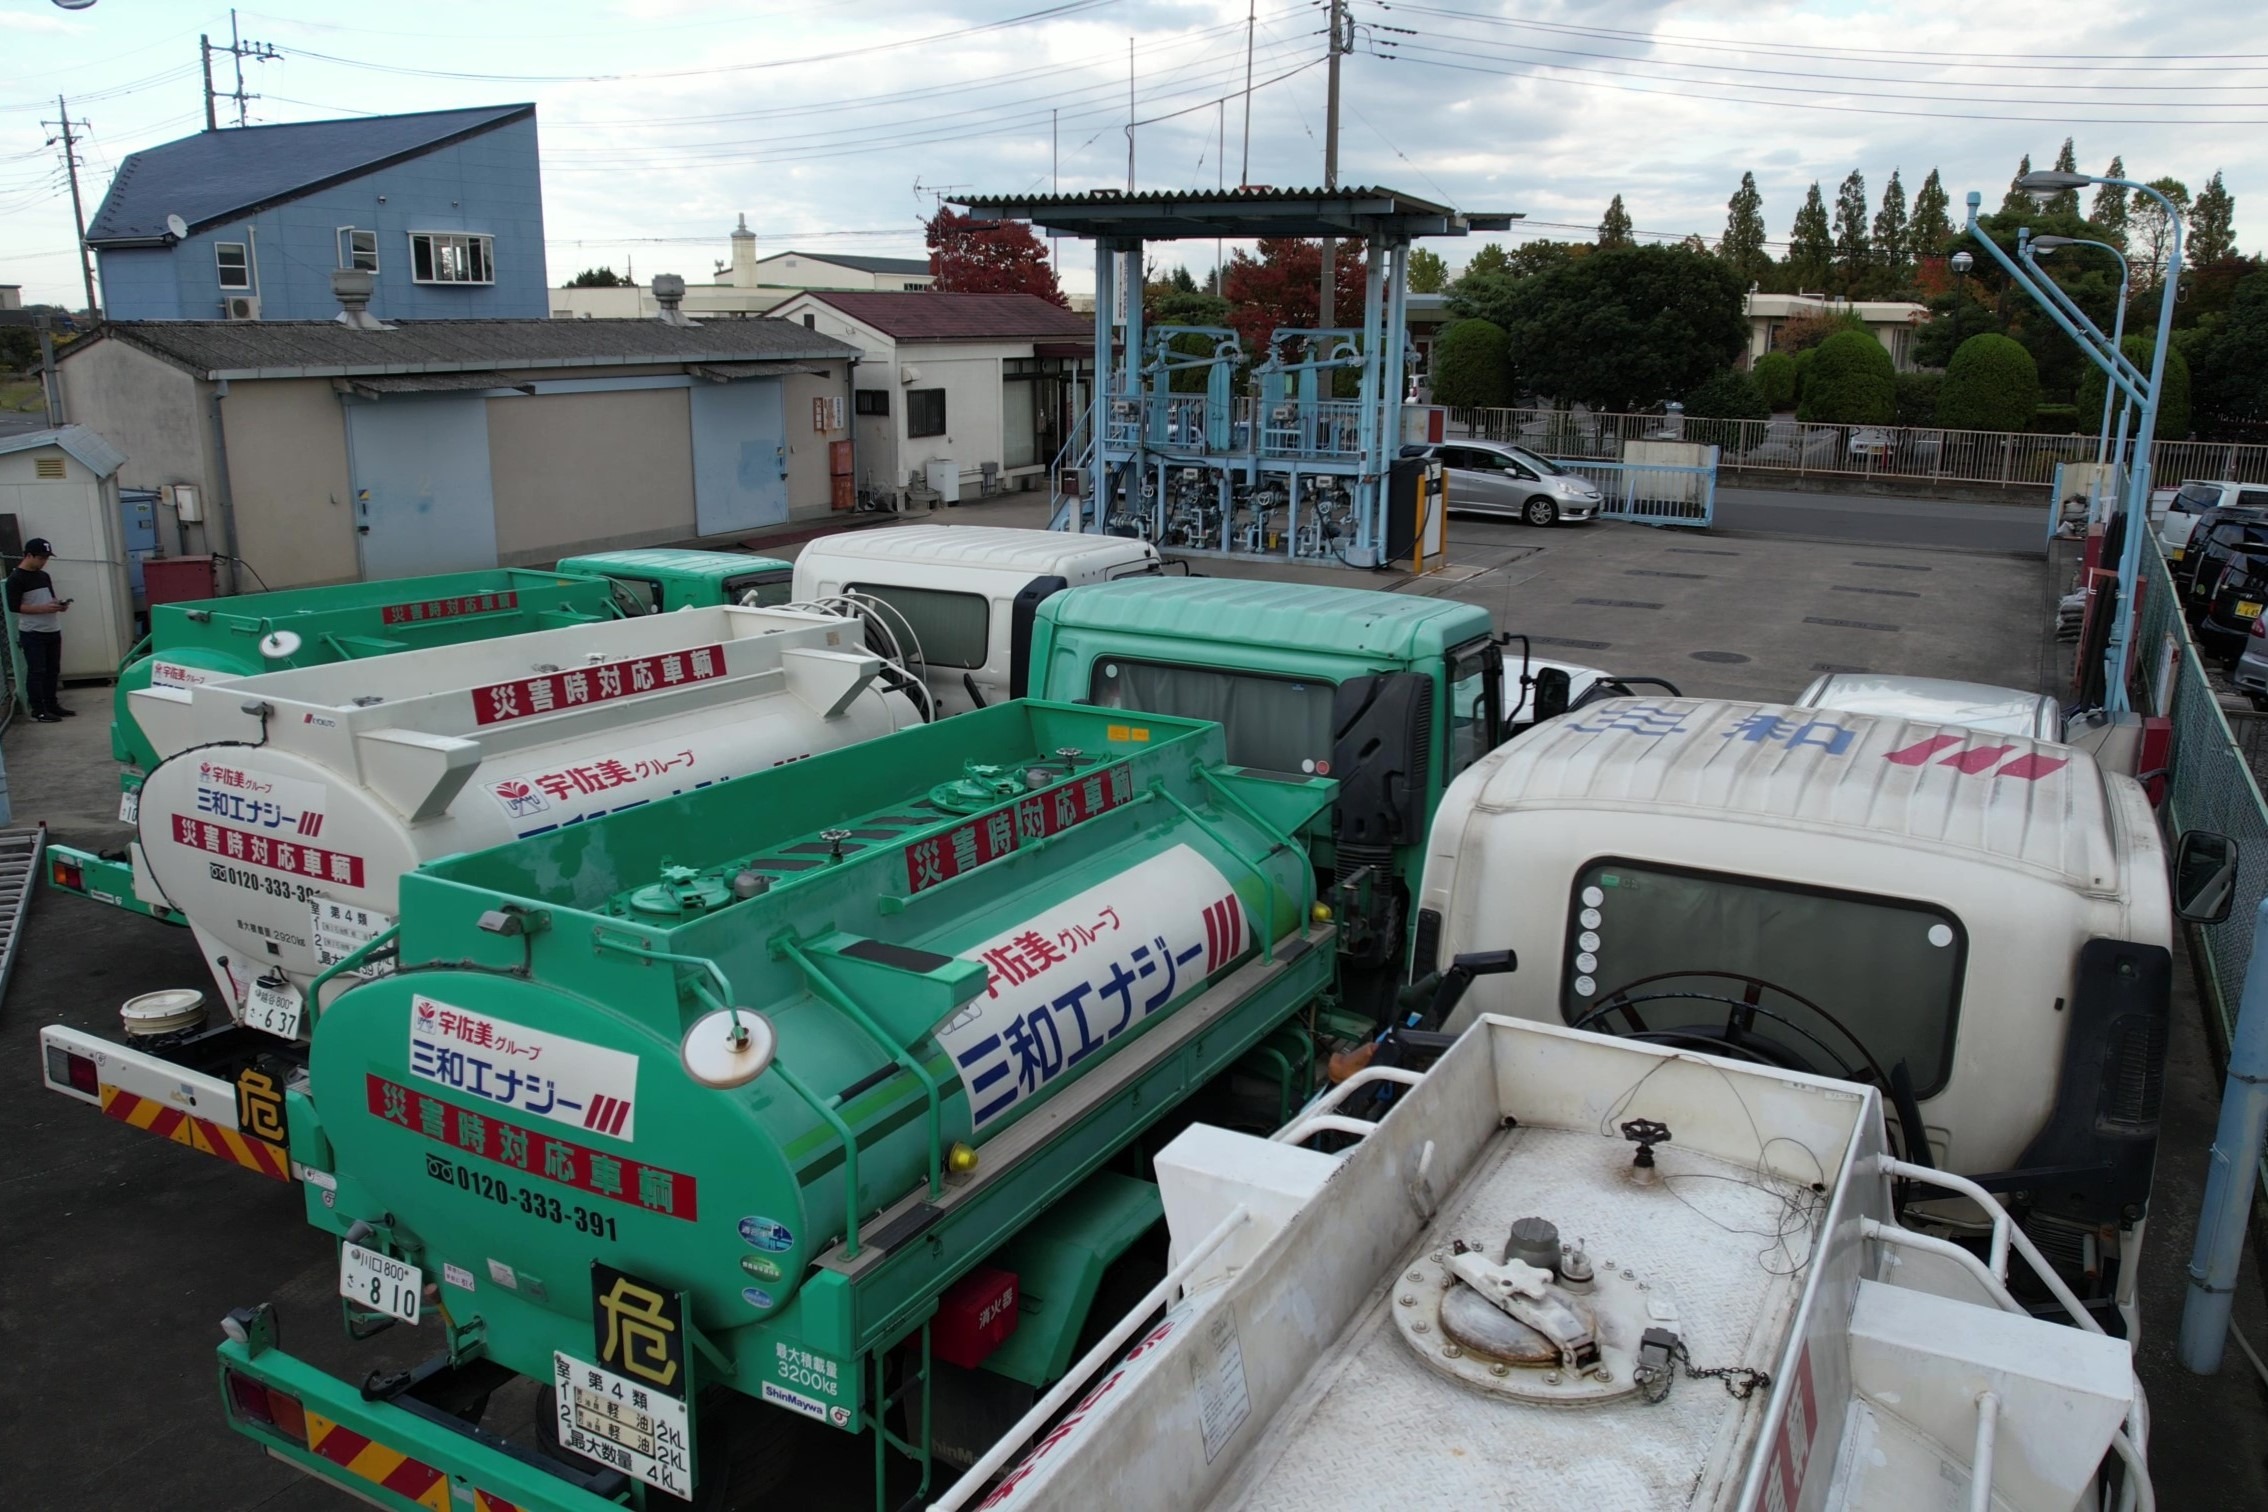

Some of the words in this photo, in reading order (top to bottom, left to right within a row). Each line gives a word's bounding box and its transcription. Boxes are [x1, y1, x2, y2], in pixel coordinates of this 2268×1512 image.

[163, 665, 206, 684] 宇佐美グループ
[1564, 706, 1857, 756] 三和
[213, 765, 273, 795] 宇佐美グループ
[534, 749, 696, 803] 宇佐美グループ
[197, 787, 297, 829] 三和エナジー
[330, 905, 368, 927] 第4類
[438, 1010, 543, 1061] 宇佐美グループ
[956, 934, 1204, 1126] 三和エナジー
[411, 1038, 583, 1116] 三和エナジー
[237, 1067, 284, 1142] 危
[457, 1165, 618, 1243] 0120-333-391
[978, 1286, 1013, 1331] 消火器
[599, 1277, 677, 1387] 危
[776, 1341, 839, 1380] 最大積載量
[777, 1360, 838, 1397] 3200kg
[557, 1359, 572, 1381] 室
[587, 1369, 649, 1412] 第4類
[765, 1385, 824, 1416] ShinMaywa
[560, 1404, 572, 1423] 2
[569, 1429, 634, 1472] 最大数量
